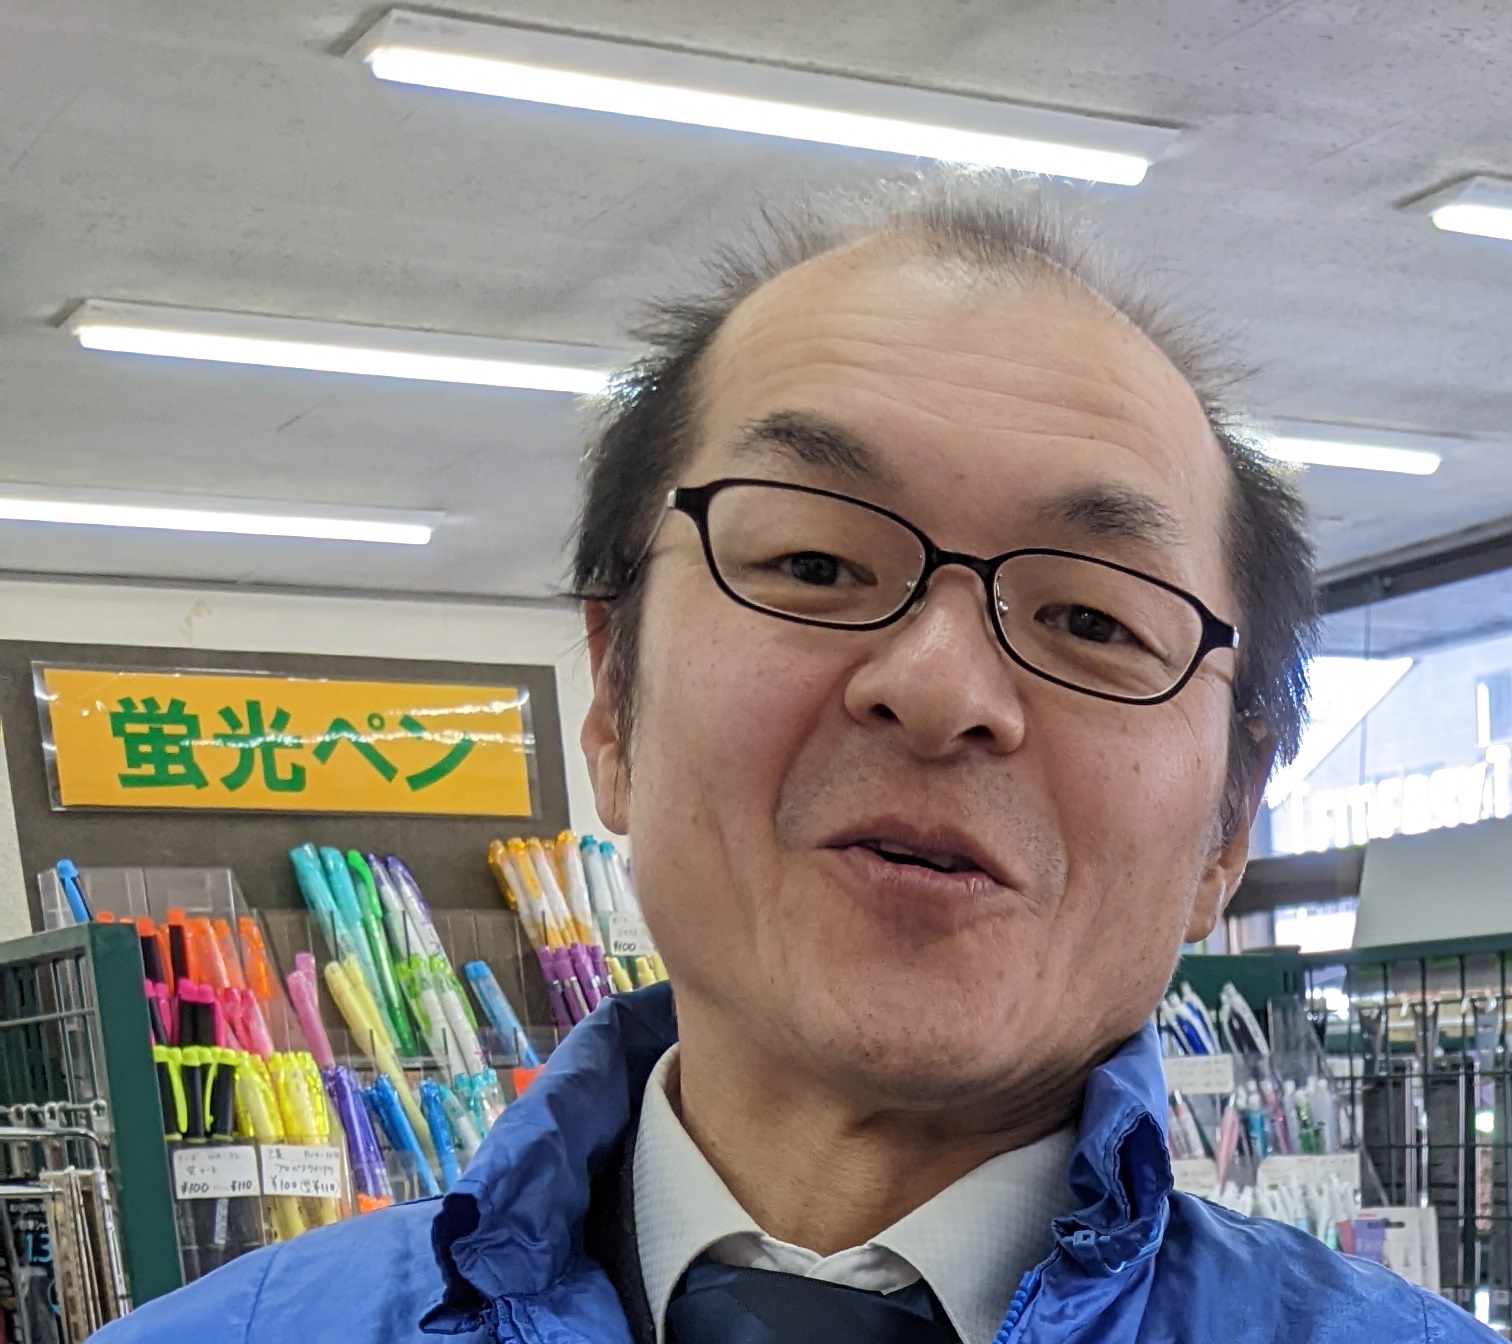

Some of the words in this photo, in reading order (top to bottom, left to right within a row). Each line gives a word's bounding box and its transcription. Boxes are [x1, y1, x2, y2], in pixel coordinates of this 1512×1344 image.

[109, 696, 475, 792] 蛍光ペン
[181, 1181, 210, 1195] ¥100
[270, 1174, 297, 1192] ¥100
